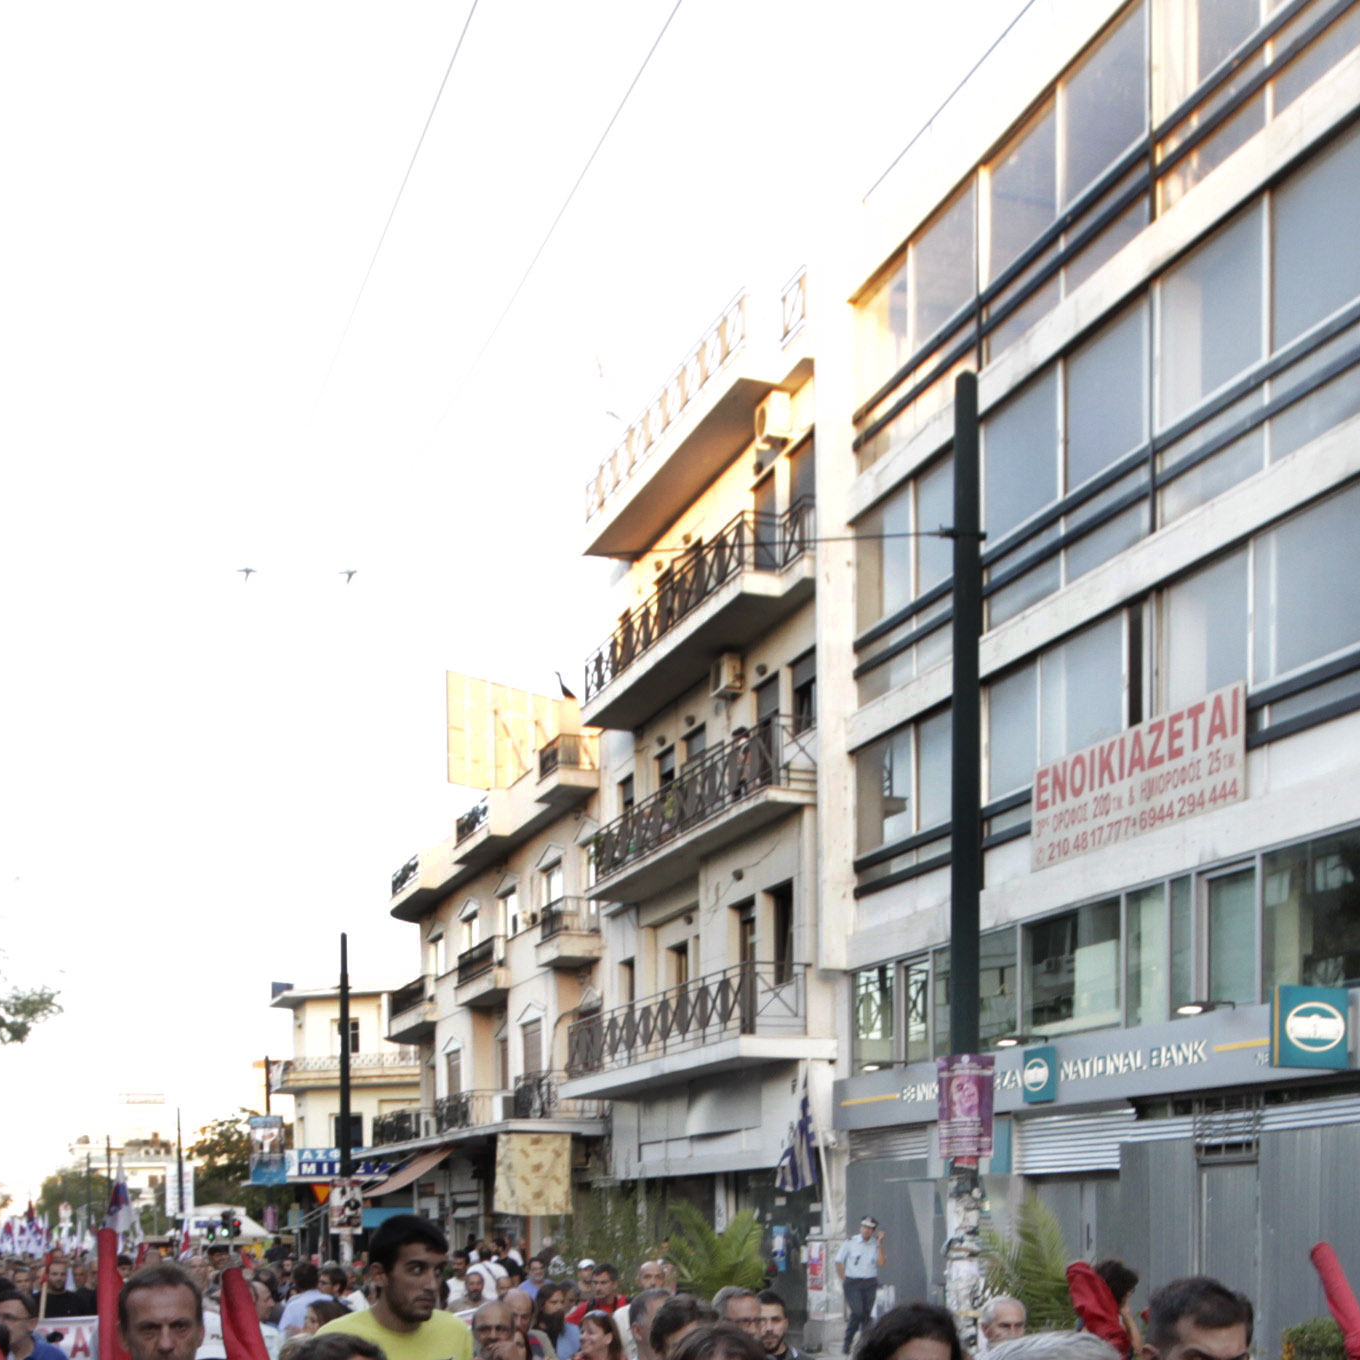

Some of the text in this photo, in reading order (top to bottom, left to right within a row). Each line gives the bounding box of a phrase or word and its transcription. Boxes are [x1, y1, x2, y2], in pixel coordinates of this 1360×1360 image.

[1035, 686, 1240, 812] ΕΝΟΙΚΙΑΖΕΤΑΙ
[1059, 1039, 1210, 1083] NATIONAL BANK
